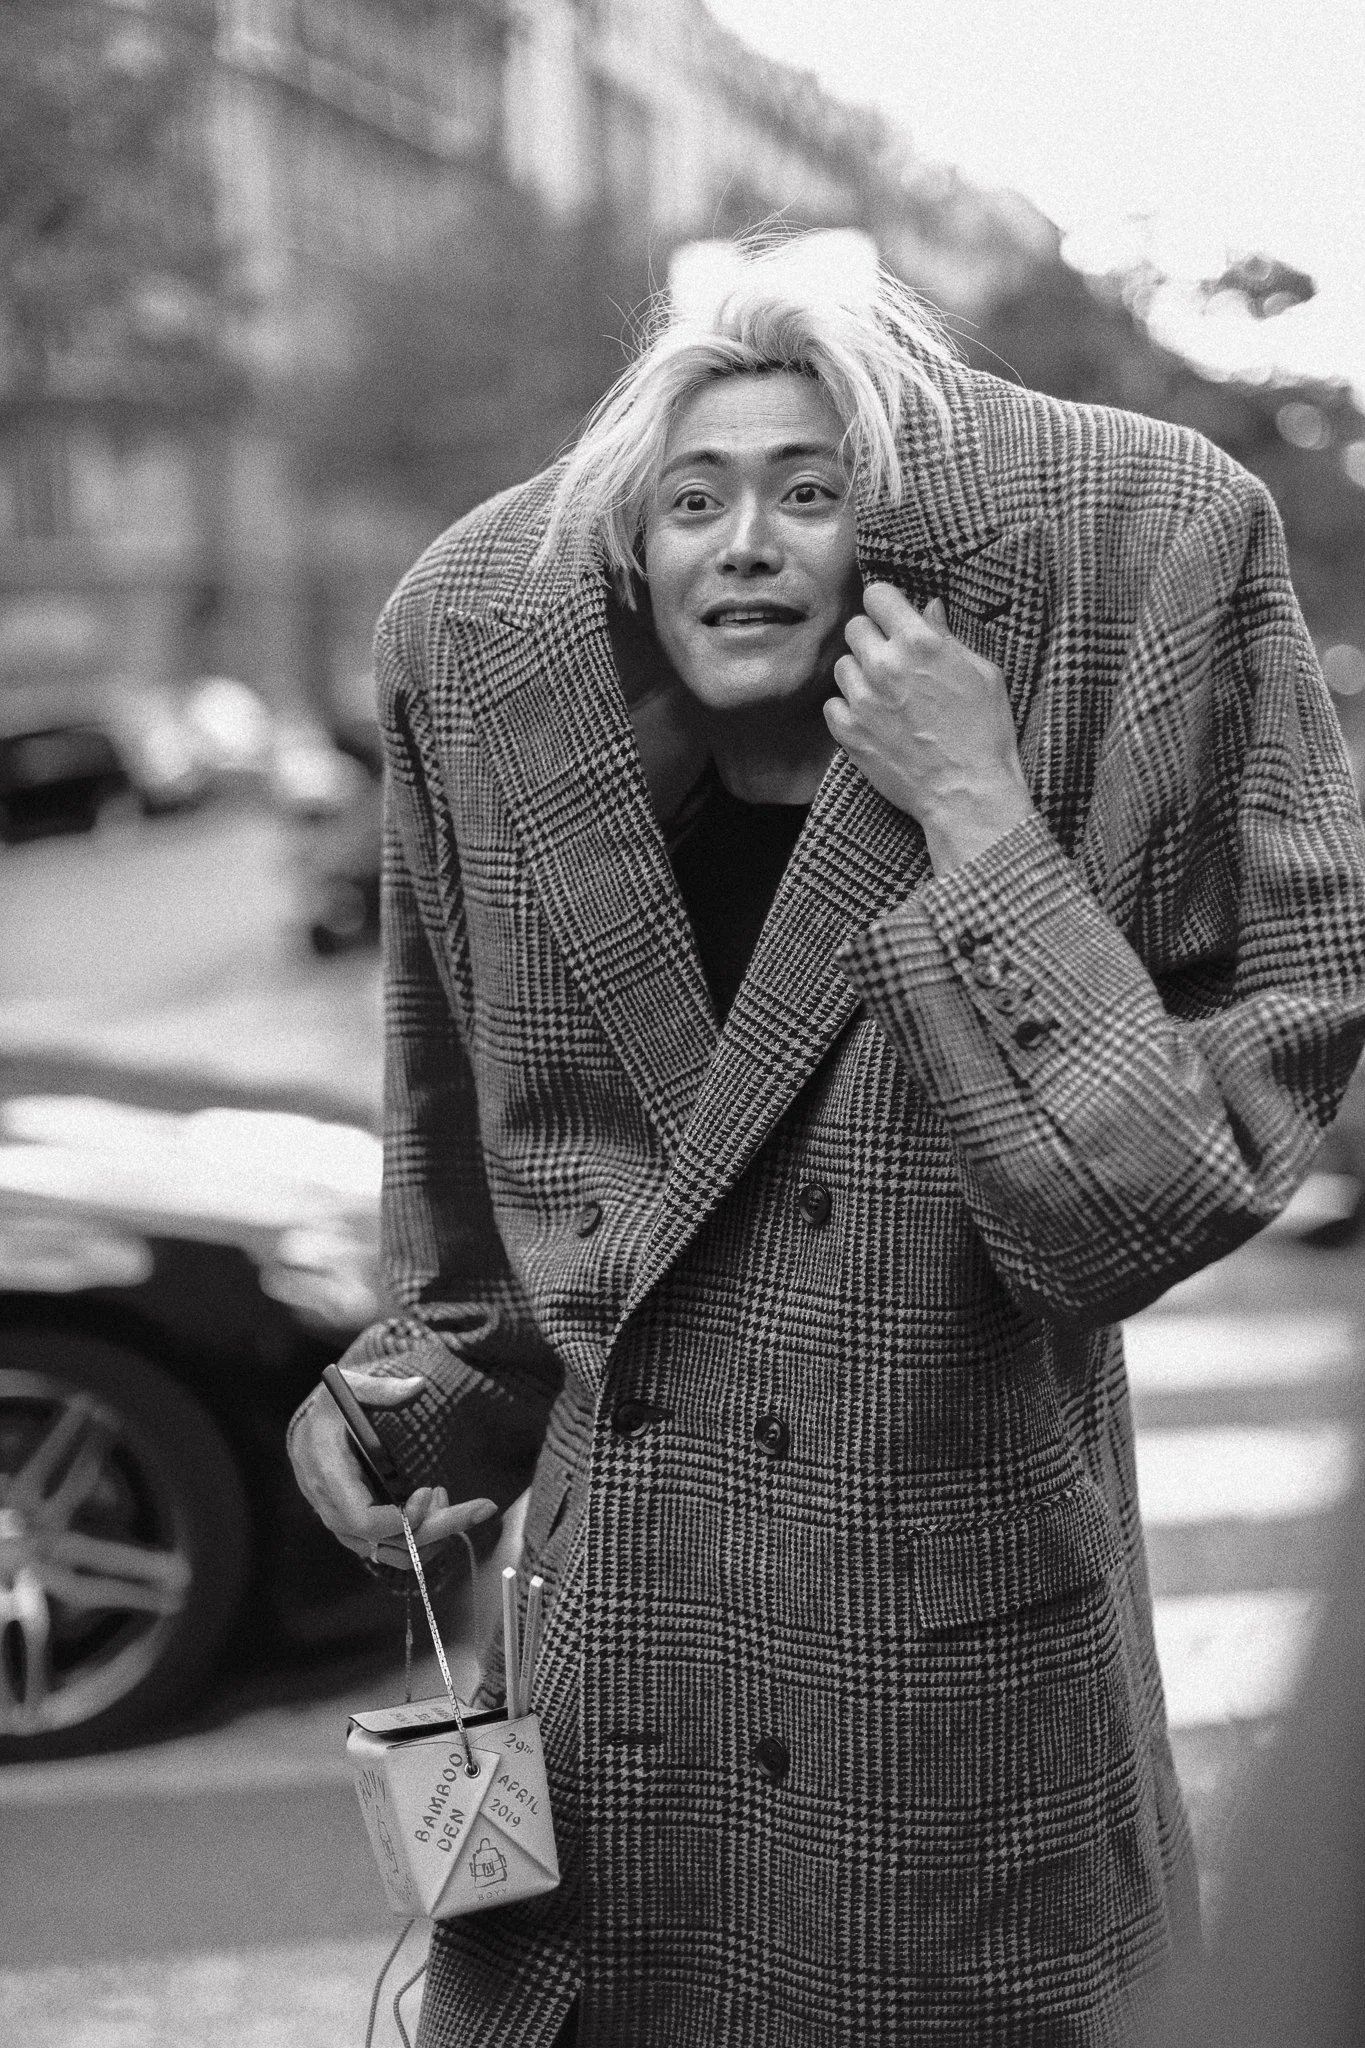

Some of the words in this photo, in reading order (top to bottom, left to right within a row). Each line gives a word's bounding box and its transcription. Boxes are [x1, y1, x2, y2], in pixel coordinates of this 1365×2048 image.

[503, 1732, 534, 1754] 29TH
[414, 1752, 464, 1843] BAMBOO
[488, 1798, 521, 1828] 2019
[497, 1774, 539, 1815] APRIL
[436, 1808, 465, 1852] DEN
